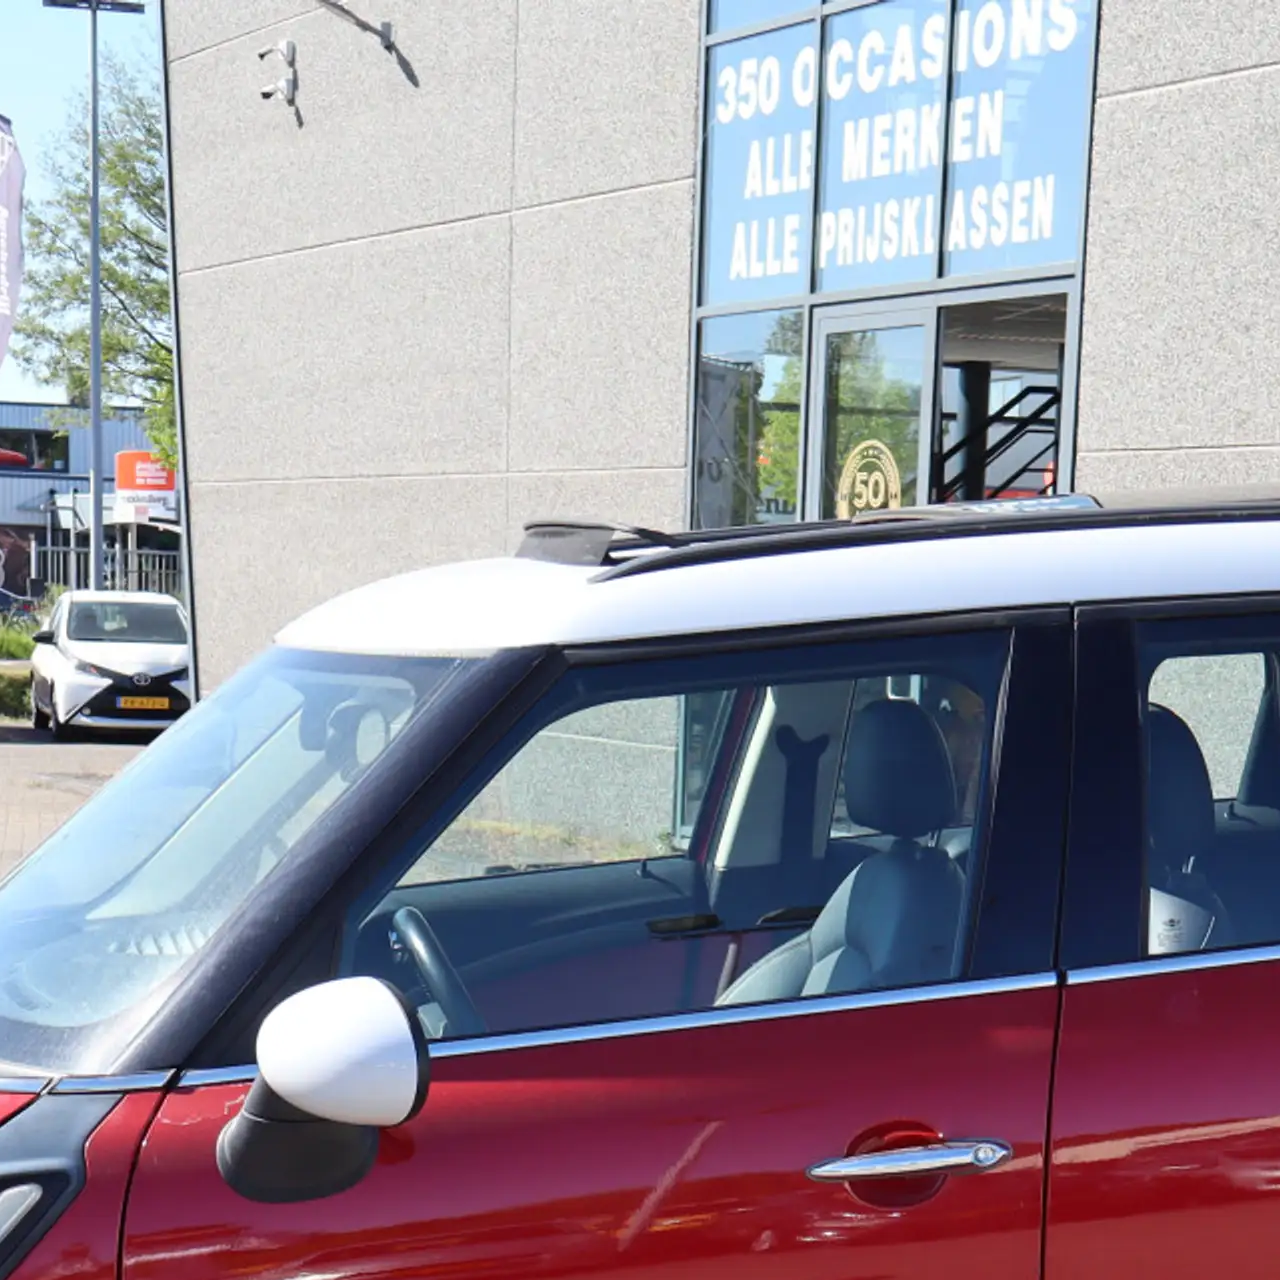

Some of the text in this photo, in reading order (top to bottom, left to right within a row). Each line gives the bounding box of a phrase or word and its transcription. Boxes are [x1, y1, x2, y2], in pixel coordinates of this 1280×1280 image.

[715, 0, 1078, 125] 350 OCCASIONS
[744, 89, 1005, 200] ALLE MERKEN
[729, 174, 1056, 281] ALLE PRIJSKLASSEN
[851, 471, 887, 509] 50
